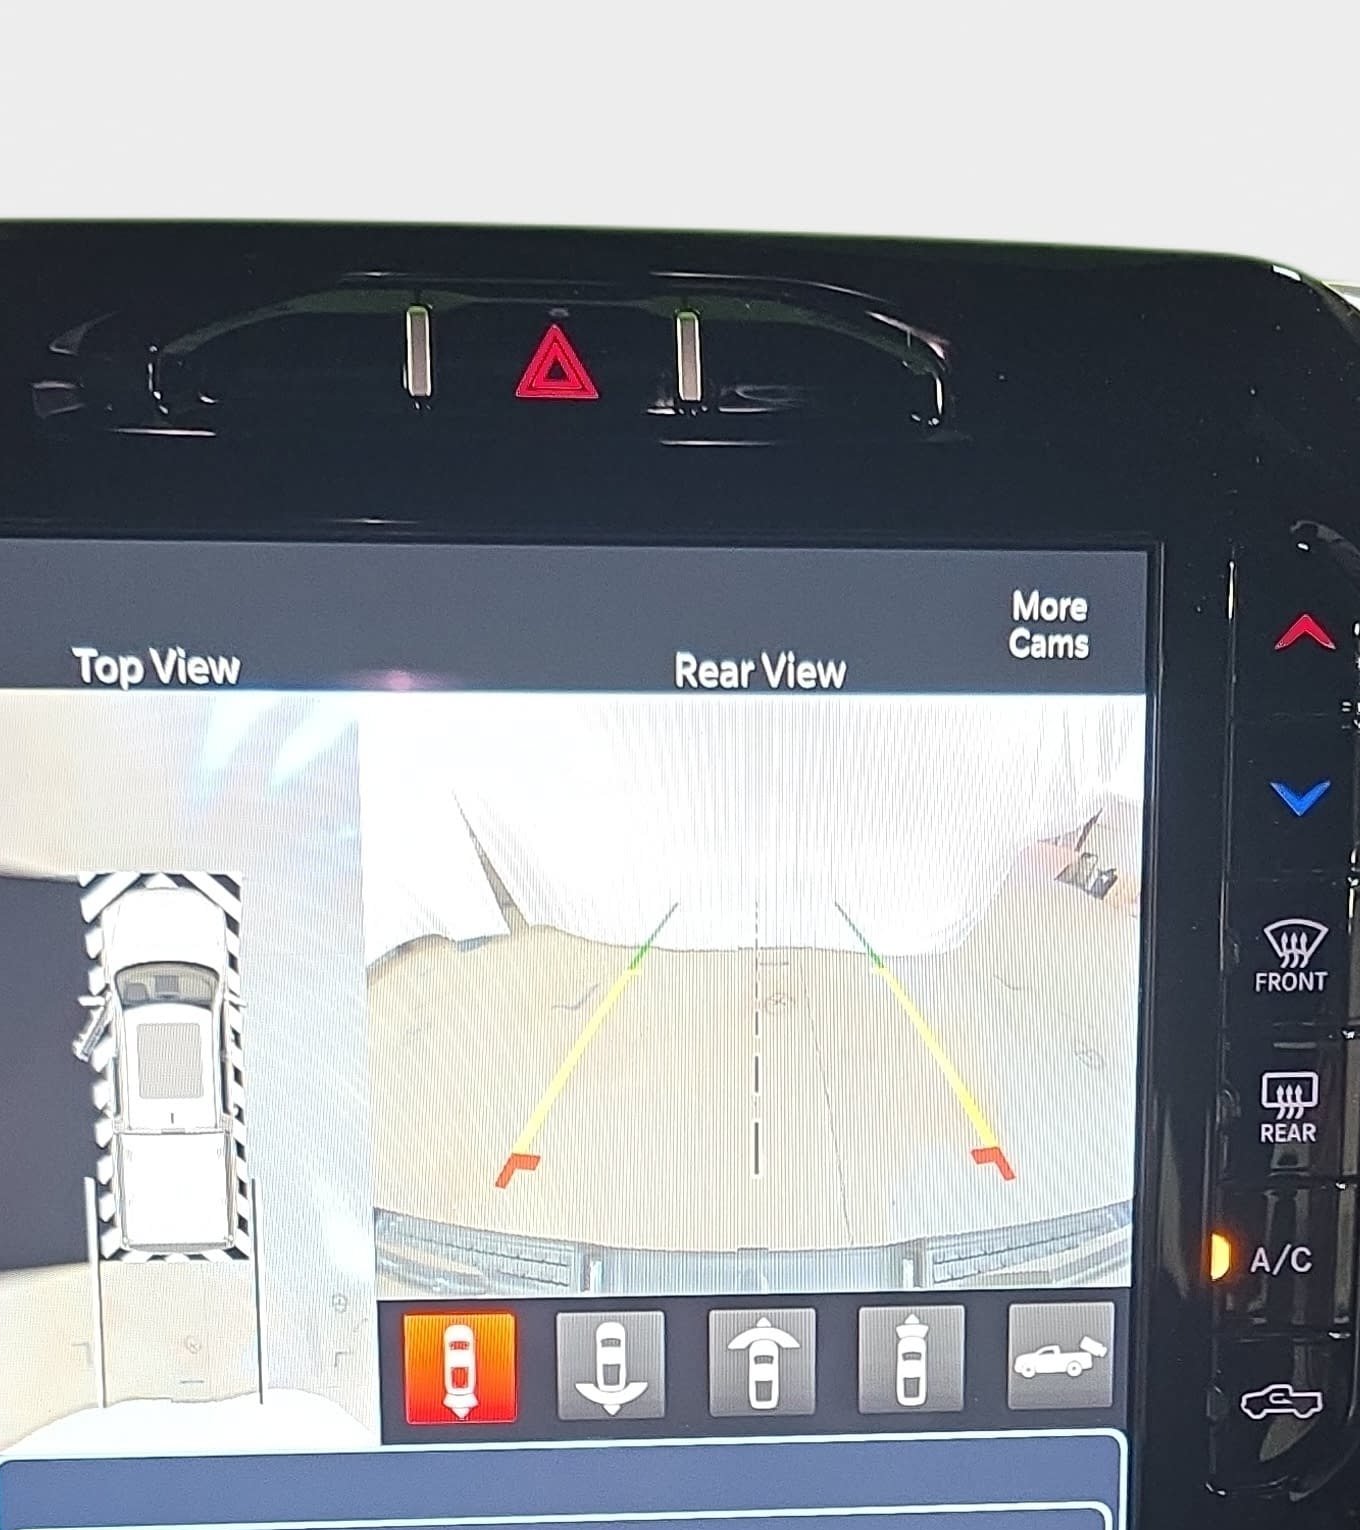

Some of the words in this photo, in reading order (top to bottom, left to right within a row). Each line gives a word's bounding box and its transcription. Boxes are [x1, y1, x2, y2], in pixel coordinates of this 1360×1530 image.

[1012, 588, 1088, 623] More
[1008, 627, 1090, 660] Cams
[72, 647, 144, 690] Top
[150, 646, 241, 686] View
[674, 651, 755, 689] Rear
[762, 651, 847, 689] View
[1255, 971, 1328, 992] FRONT
[1260, 1122, 1317, 1143] REAR
[1249, 1243, 1313, 1275] A/C
